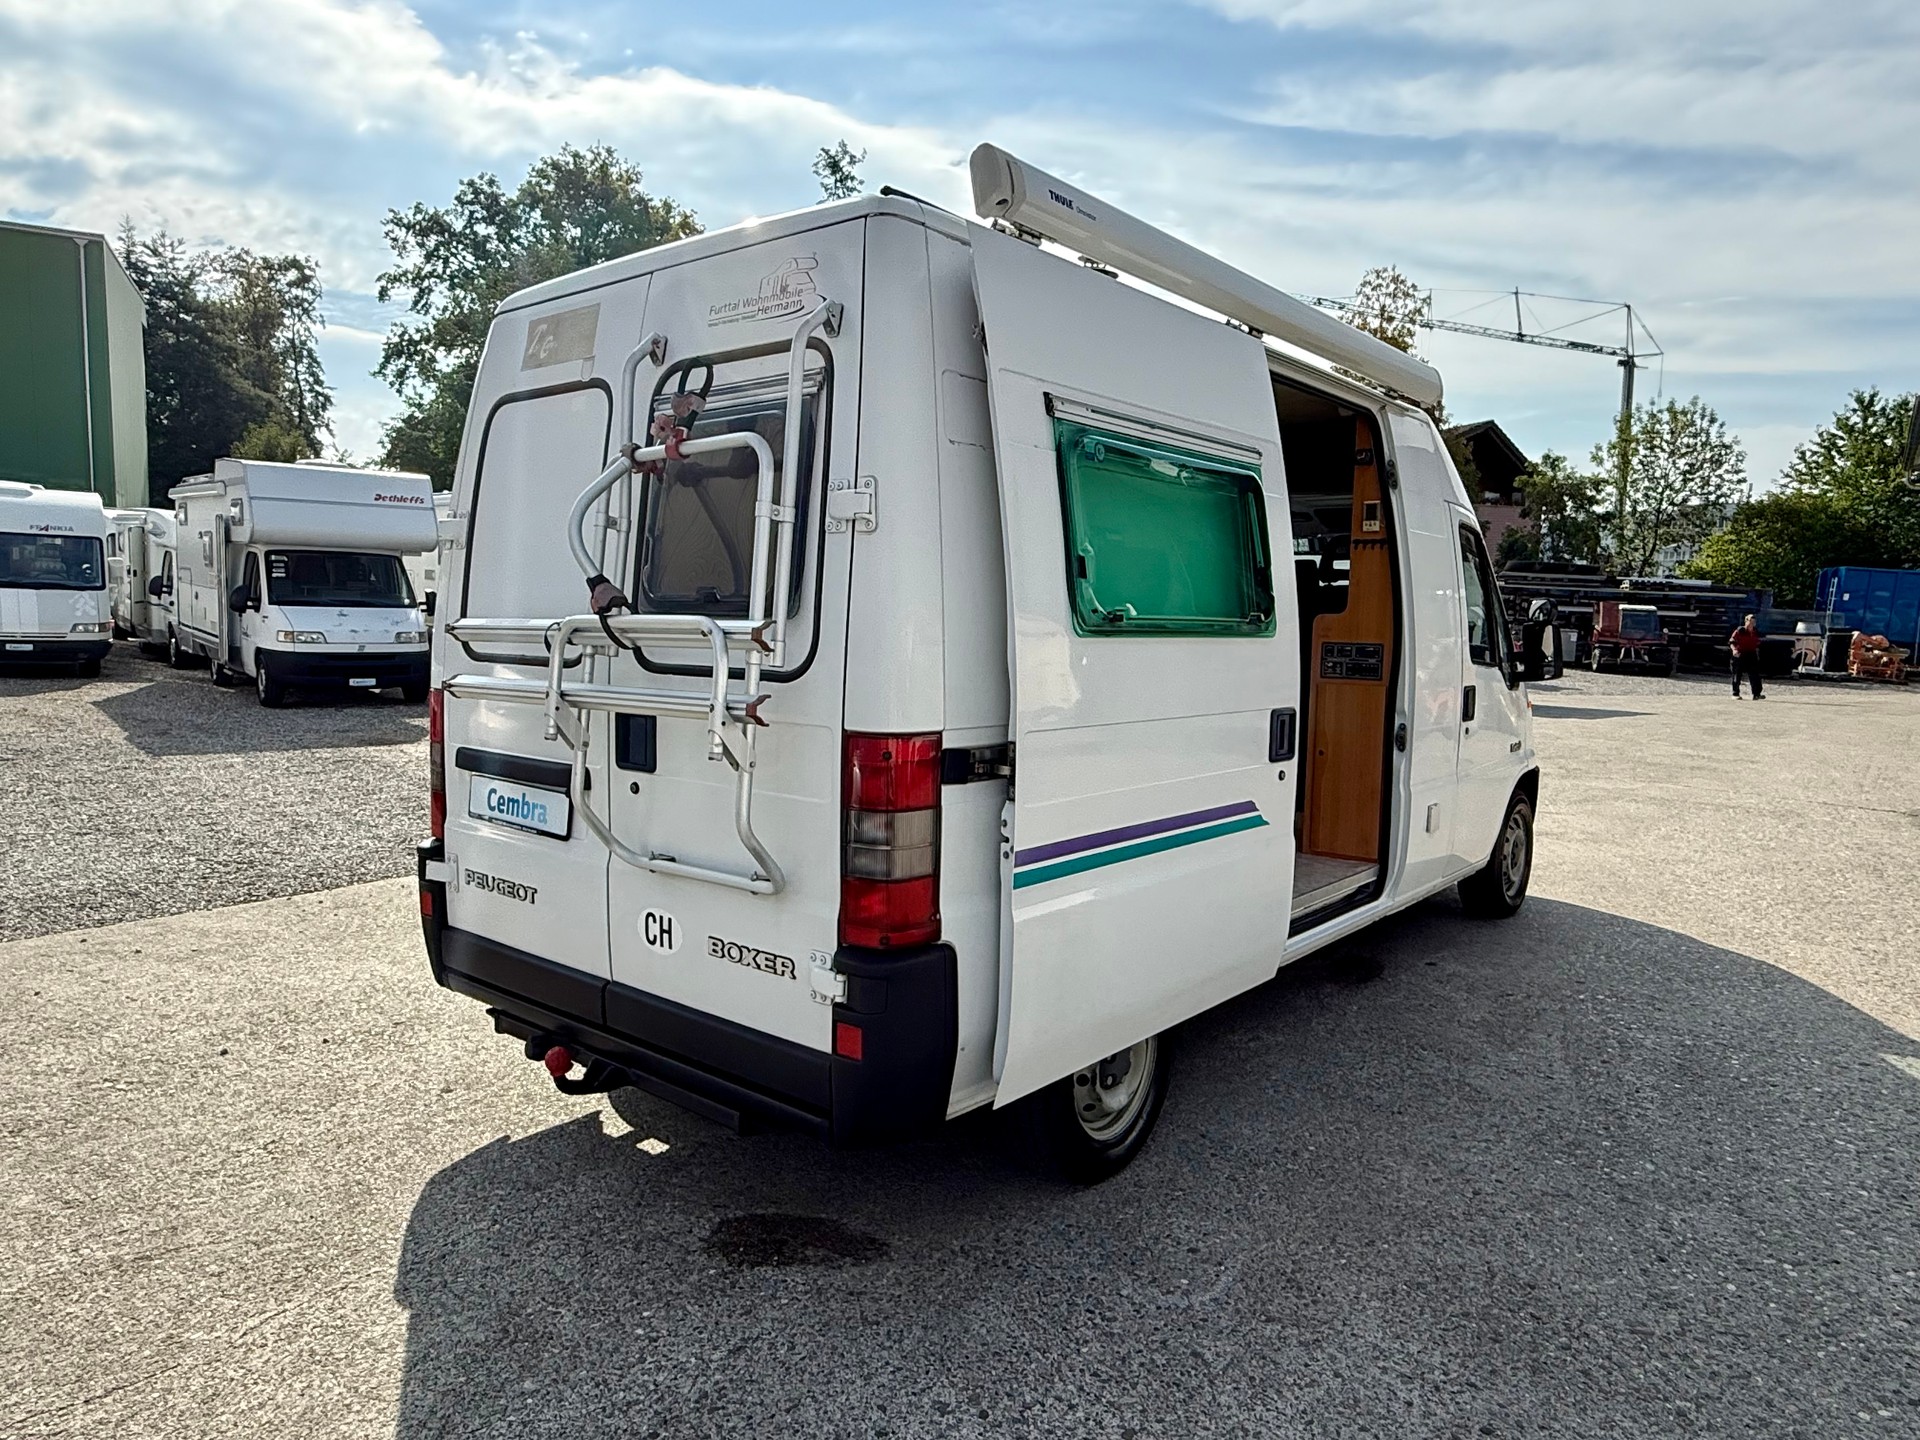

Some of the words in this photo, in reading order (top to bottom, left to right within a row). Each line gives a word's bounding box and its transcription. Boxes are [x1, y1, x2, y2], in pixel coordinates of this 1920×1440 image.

[1048, 188, 1075, 211] THULE
[708, 299, 741, 316] Furttal
[742, 287, 804, 309] Wohnmobile
[757, 298, 803, 316] Hermann
[374, 493, 425, 504] Dethleffs
[486, 787, 548, 825] Cembra
[464, 868, 538, 905] PEUGEOT
[644, 911, 673, 950] CH
[707, 935, 797, 980] BOXER
